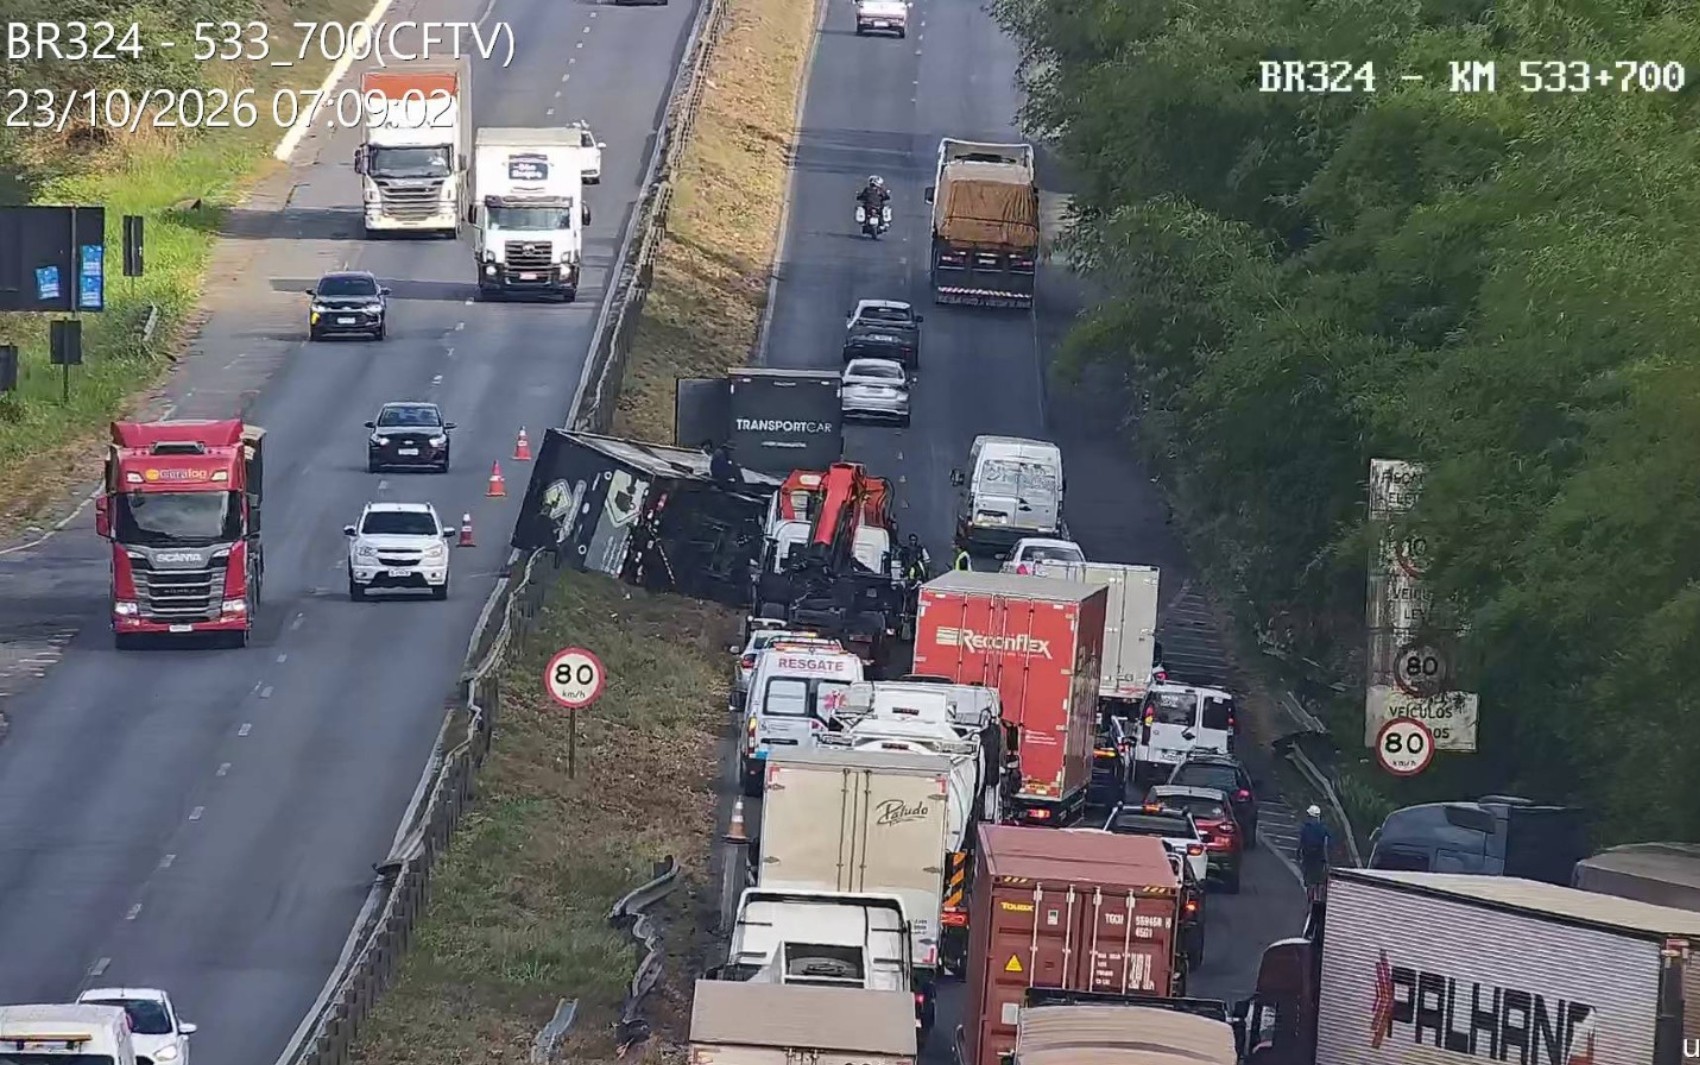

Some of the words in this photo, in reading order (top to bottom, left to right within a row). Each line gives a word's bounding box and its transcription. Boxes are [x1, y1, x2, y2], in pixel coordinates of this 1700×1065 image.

[736, 418, 833, 433] TRANSPORTCAR
[778, 657, 844, 671] RESGATE
[1407, 656, 1438, 676] 80
[555, 663, 594, 686] 80
[562, 690, 586, 699] km/h
[1385, 732, 1424, 755] 80
